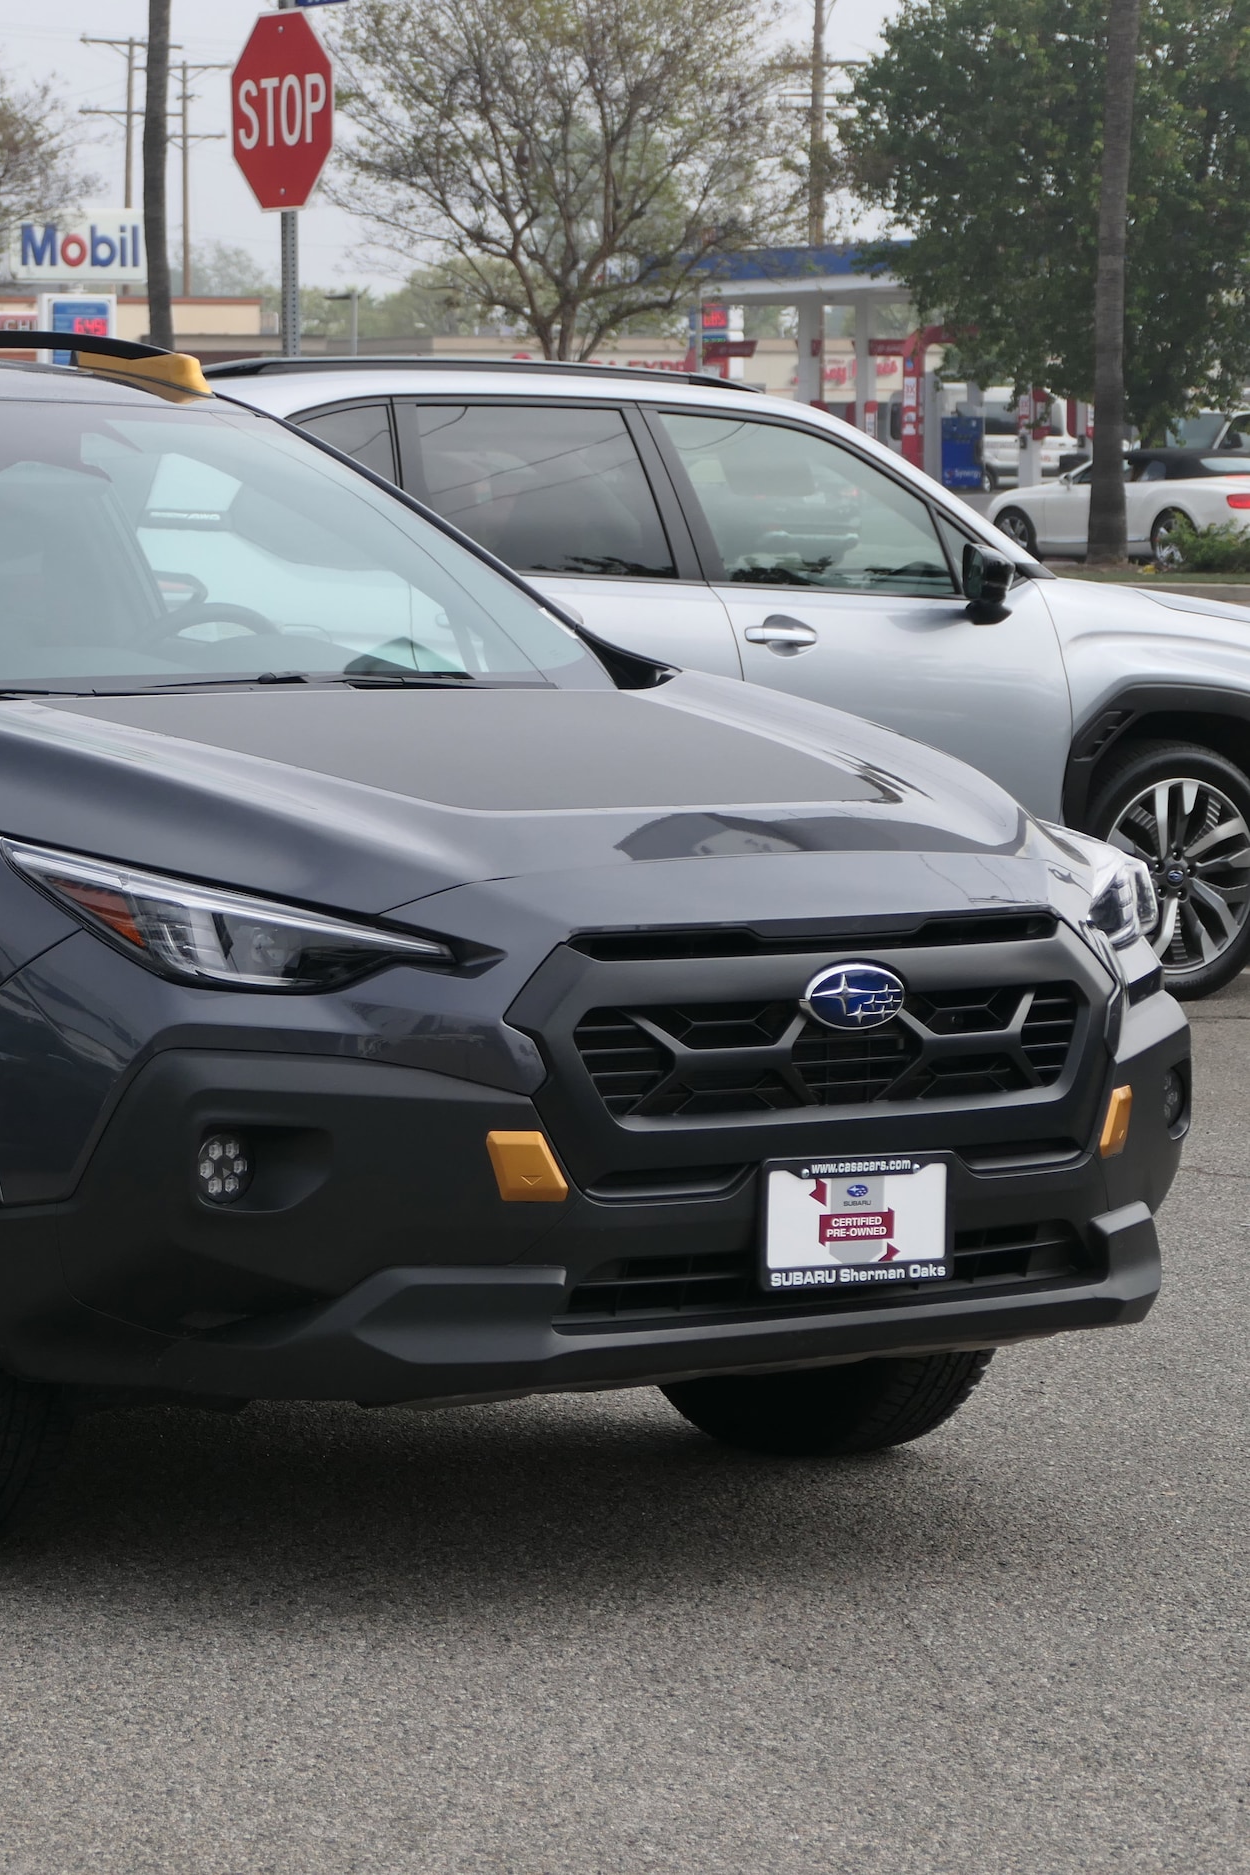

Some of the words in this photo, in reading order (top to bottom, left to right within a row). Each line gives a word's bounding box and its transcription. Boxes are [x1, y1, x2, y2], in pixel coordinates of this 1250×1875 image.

[238, 73, 327, 150] STOP
[20, 223, 141, 268] Mobil
[954, 468, 981, 479] Synergy
[811, 1159, 911, 1174] www.casacars.com
[843, 1199, 872, 1207] SUBARU
[831, 1216, 883, 1227] CERTIFIED
[826, 1226, 887, 1238] PRE-OWNED
[770, 1269, 837, 1287] SUBARU
[840, 1267, 905, 1283] Sherman
[909, 1263, 946, 1279] Oaks
